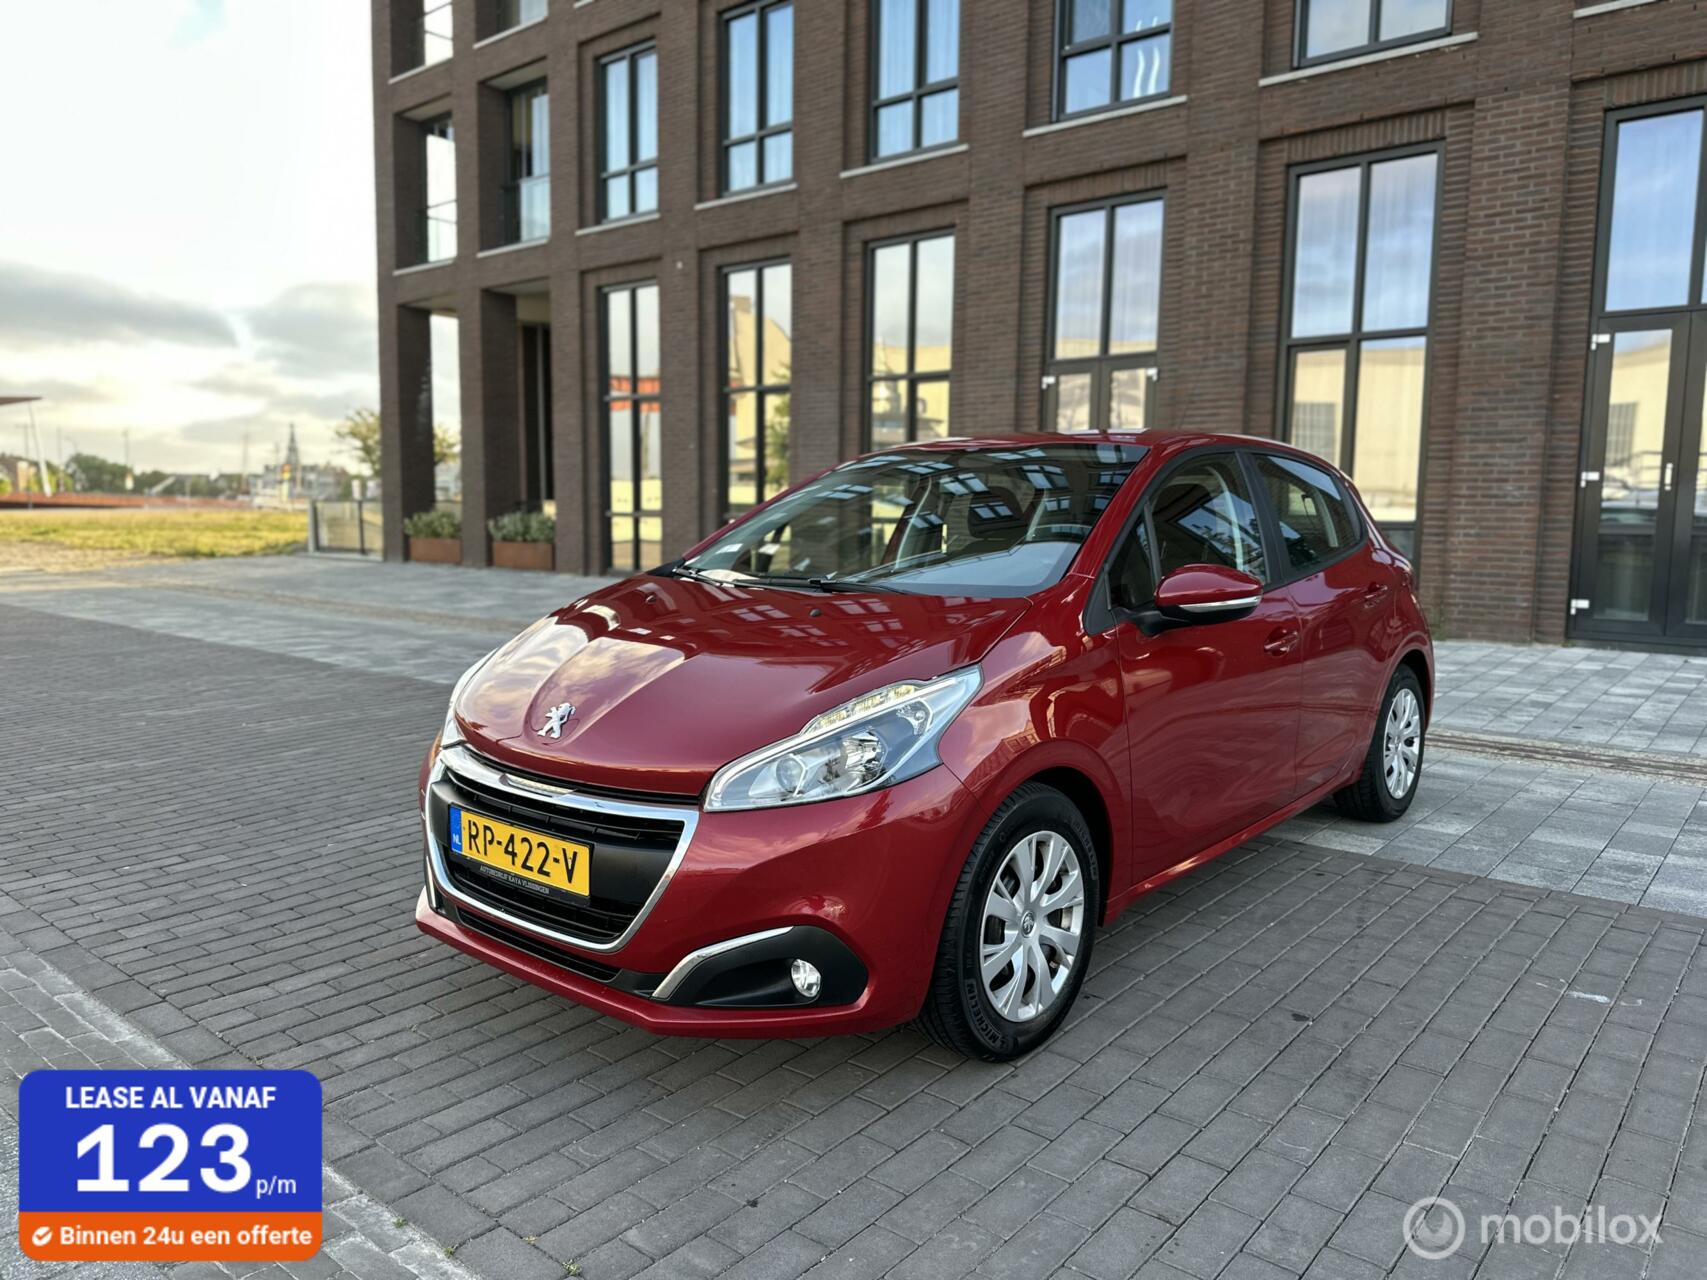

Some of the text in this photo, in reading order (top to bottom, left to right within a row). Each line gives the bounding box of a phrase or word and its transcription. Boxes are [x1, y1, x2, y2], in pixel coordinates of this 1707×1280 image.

[452, 833, 462, 846] NL
[467, 819, 578, 884] RP-422-V
[508, 875, 522, 886] KAYA
[966, 982, 1001, 1045] MICHELIN
